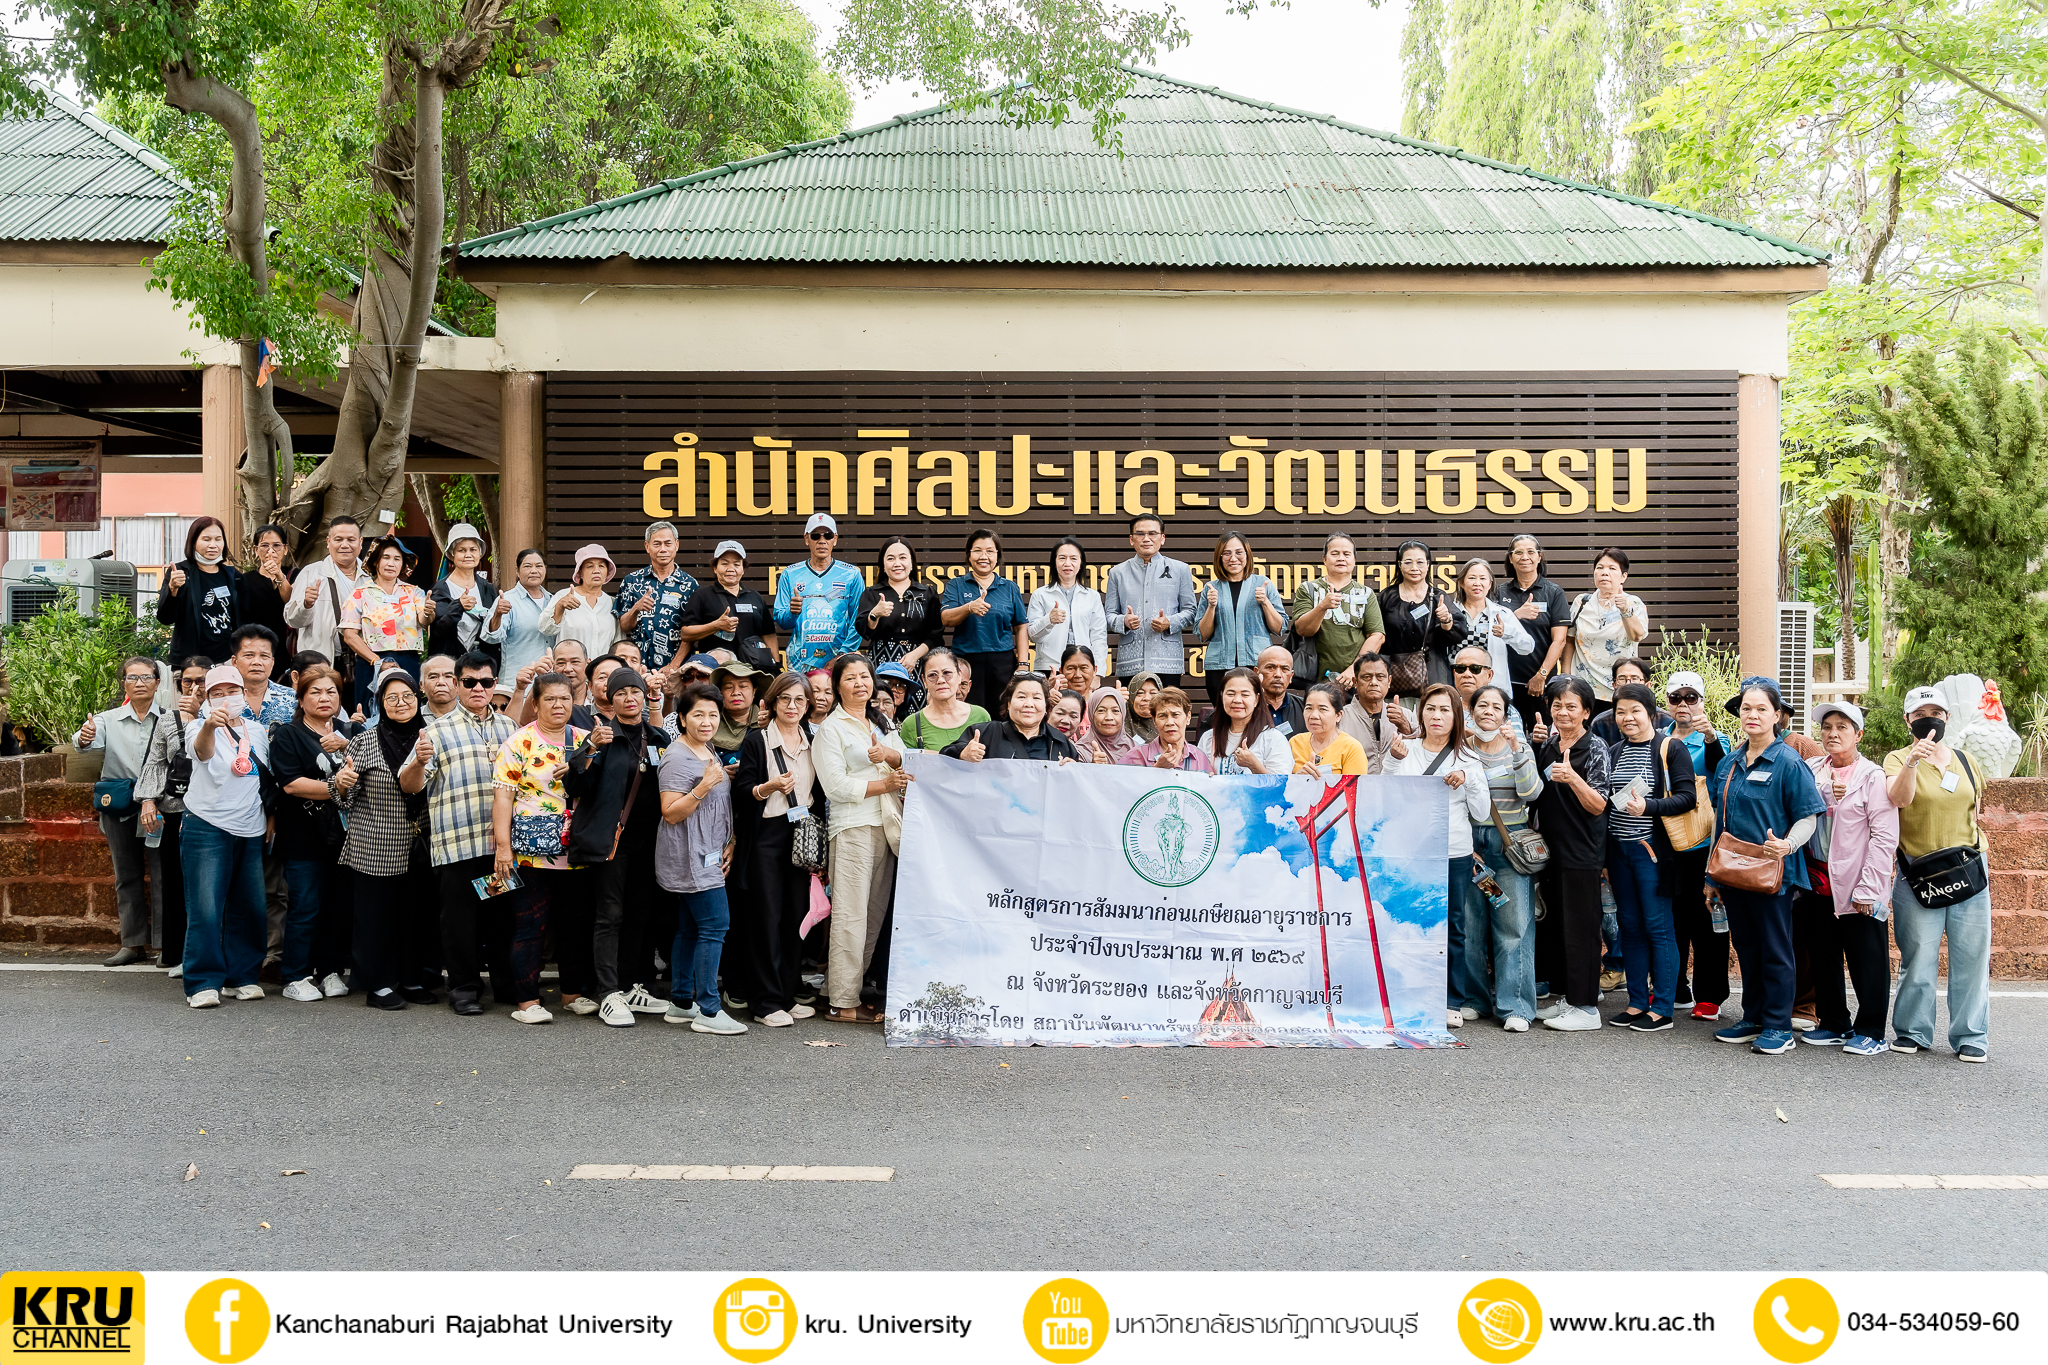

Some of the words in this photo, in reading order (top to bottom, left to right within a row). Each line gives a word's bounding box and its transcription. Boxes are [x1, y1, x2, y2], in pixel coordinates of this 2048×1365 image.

[643, 429, 1648, 518] สำนักศิลปะและวัฒนธรรม
[801, 619, 838, 633] Chang
[1920, 880, 1969, 899] KANGOL
[986, 888, 1352, 932] หลักสูตรการสัมมนาก่อนเกษียณอายุราชการ
[1030, 933, 1202, 962] ประจำปีงบประมาณ
[1210, 944, 1243, 963] พ.ศ
[1006, 974, 1024, 991] ณ
[1033, 970, 1148, 999] จังหวัดระยอง
[1156, 979, 1344, 1013] และจังหวัดกาญจนบุรี
[899, 1002, 1025, 1030] ดำเนินการโดย
